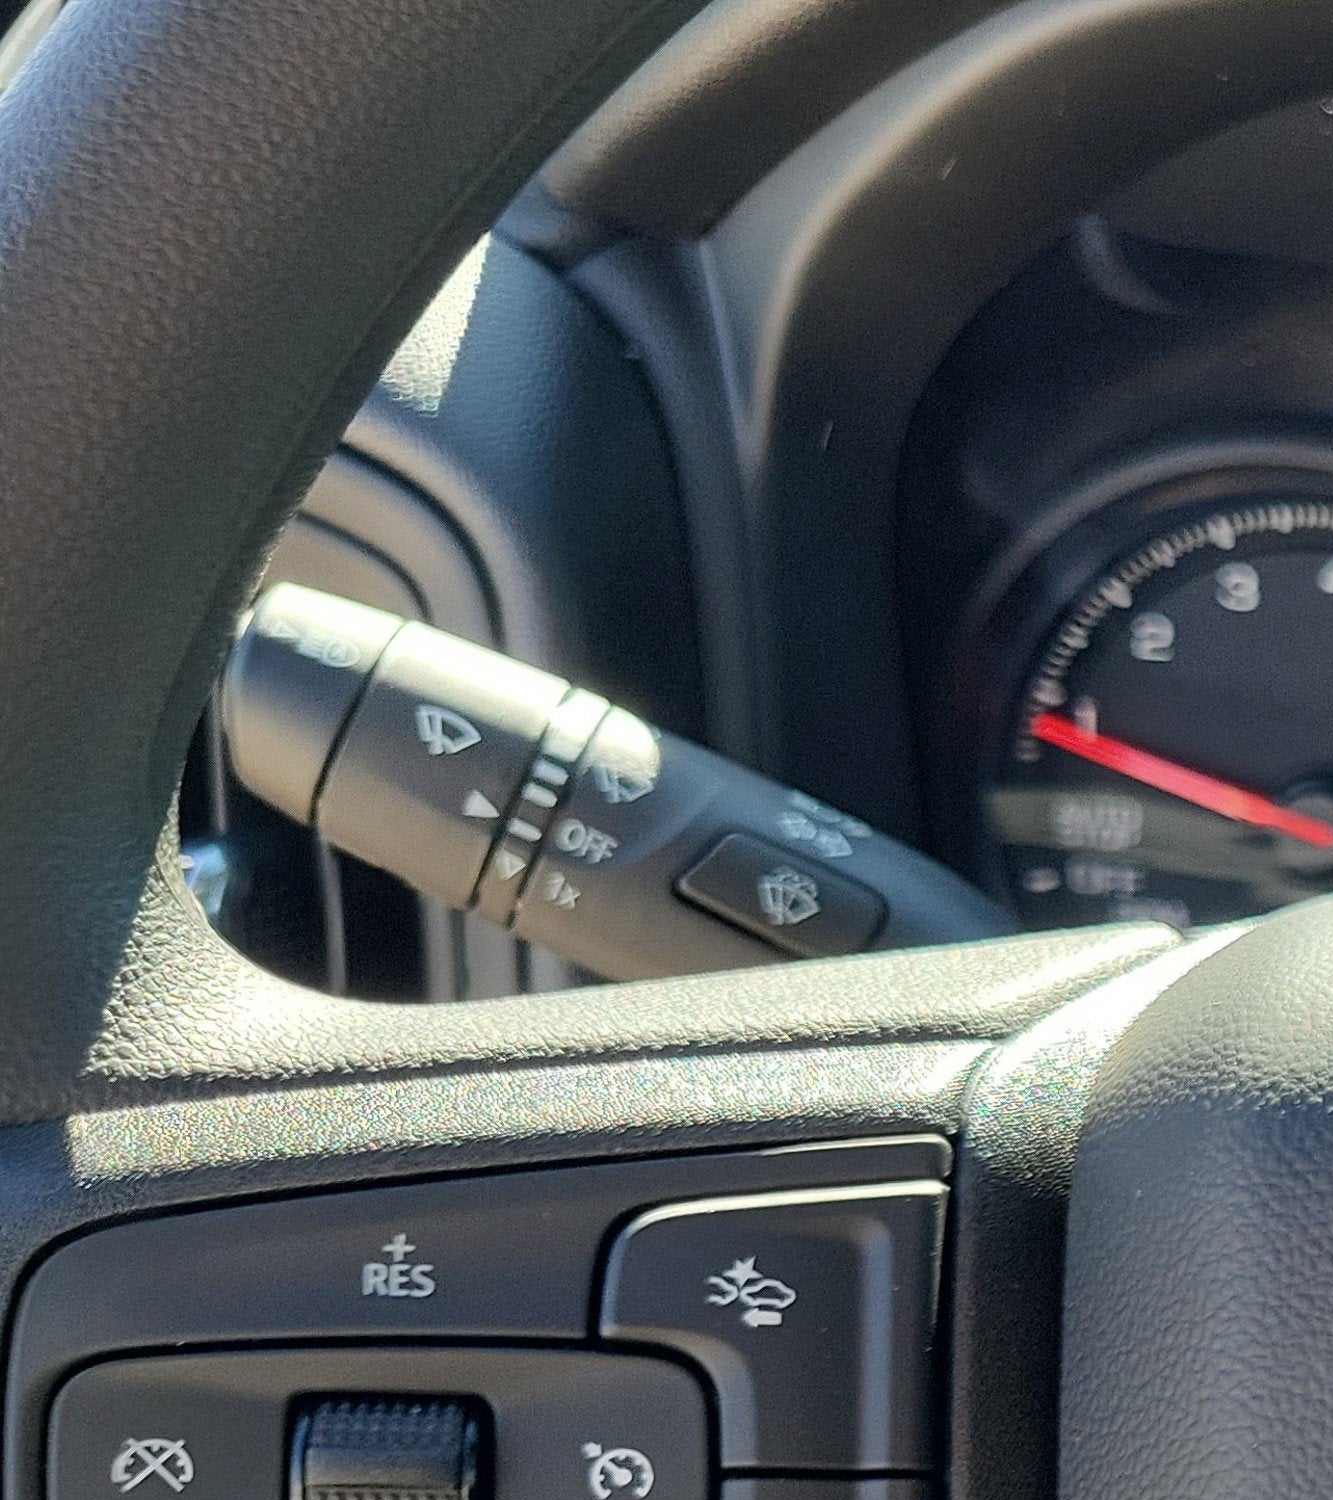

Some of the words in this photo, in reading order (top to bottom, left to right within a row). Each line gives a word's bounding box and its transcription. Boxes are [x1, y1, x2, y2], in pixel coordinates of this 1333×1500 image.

[1214, 561, 1261, 612] 3
[1130, 611, 1175, 662] 2
[555, 818, 618, 863] OFF
[361, 1262, 436, 1298] RES
